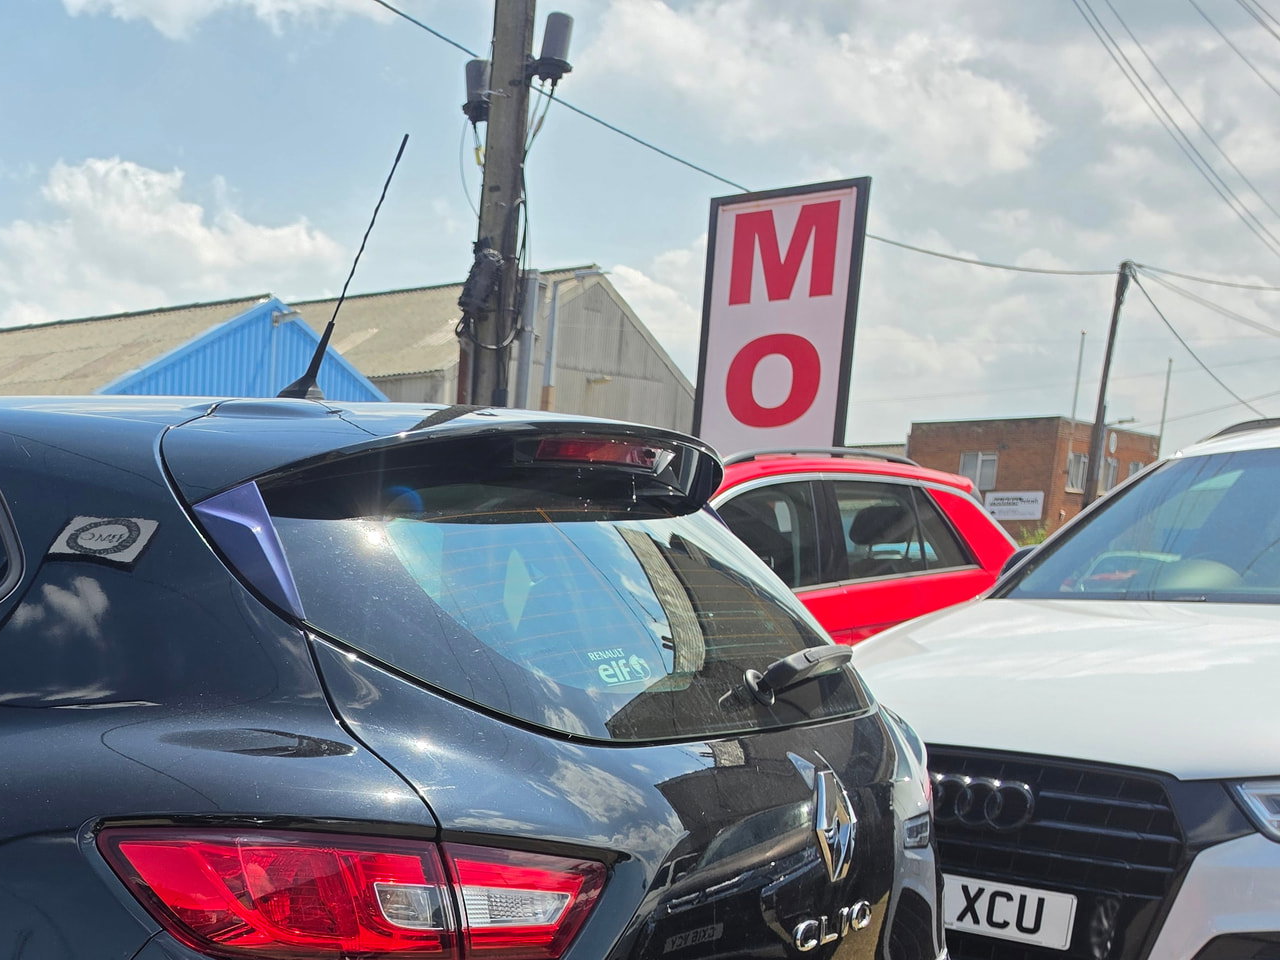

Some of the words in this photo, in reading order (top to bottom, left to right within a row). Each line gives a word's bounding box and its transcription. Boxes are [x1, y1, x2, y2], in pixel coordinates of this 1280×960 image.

[587, 648, 625, 661] RENAULT
[598, 658, 632, 683] elf
[793, 900, 872, 952] CLIO
[956, 884, 1045, 935] XCU
